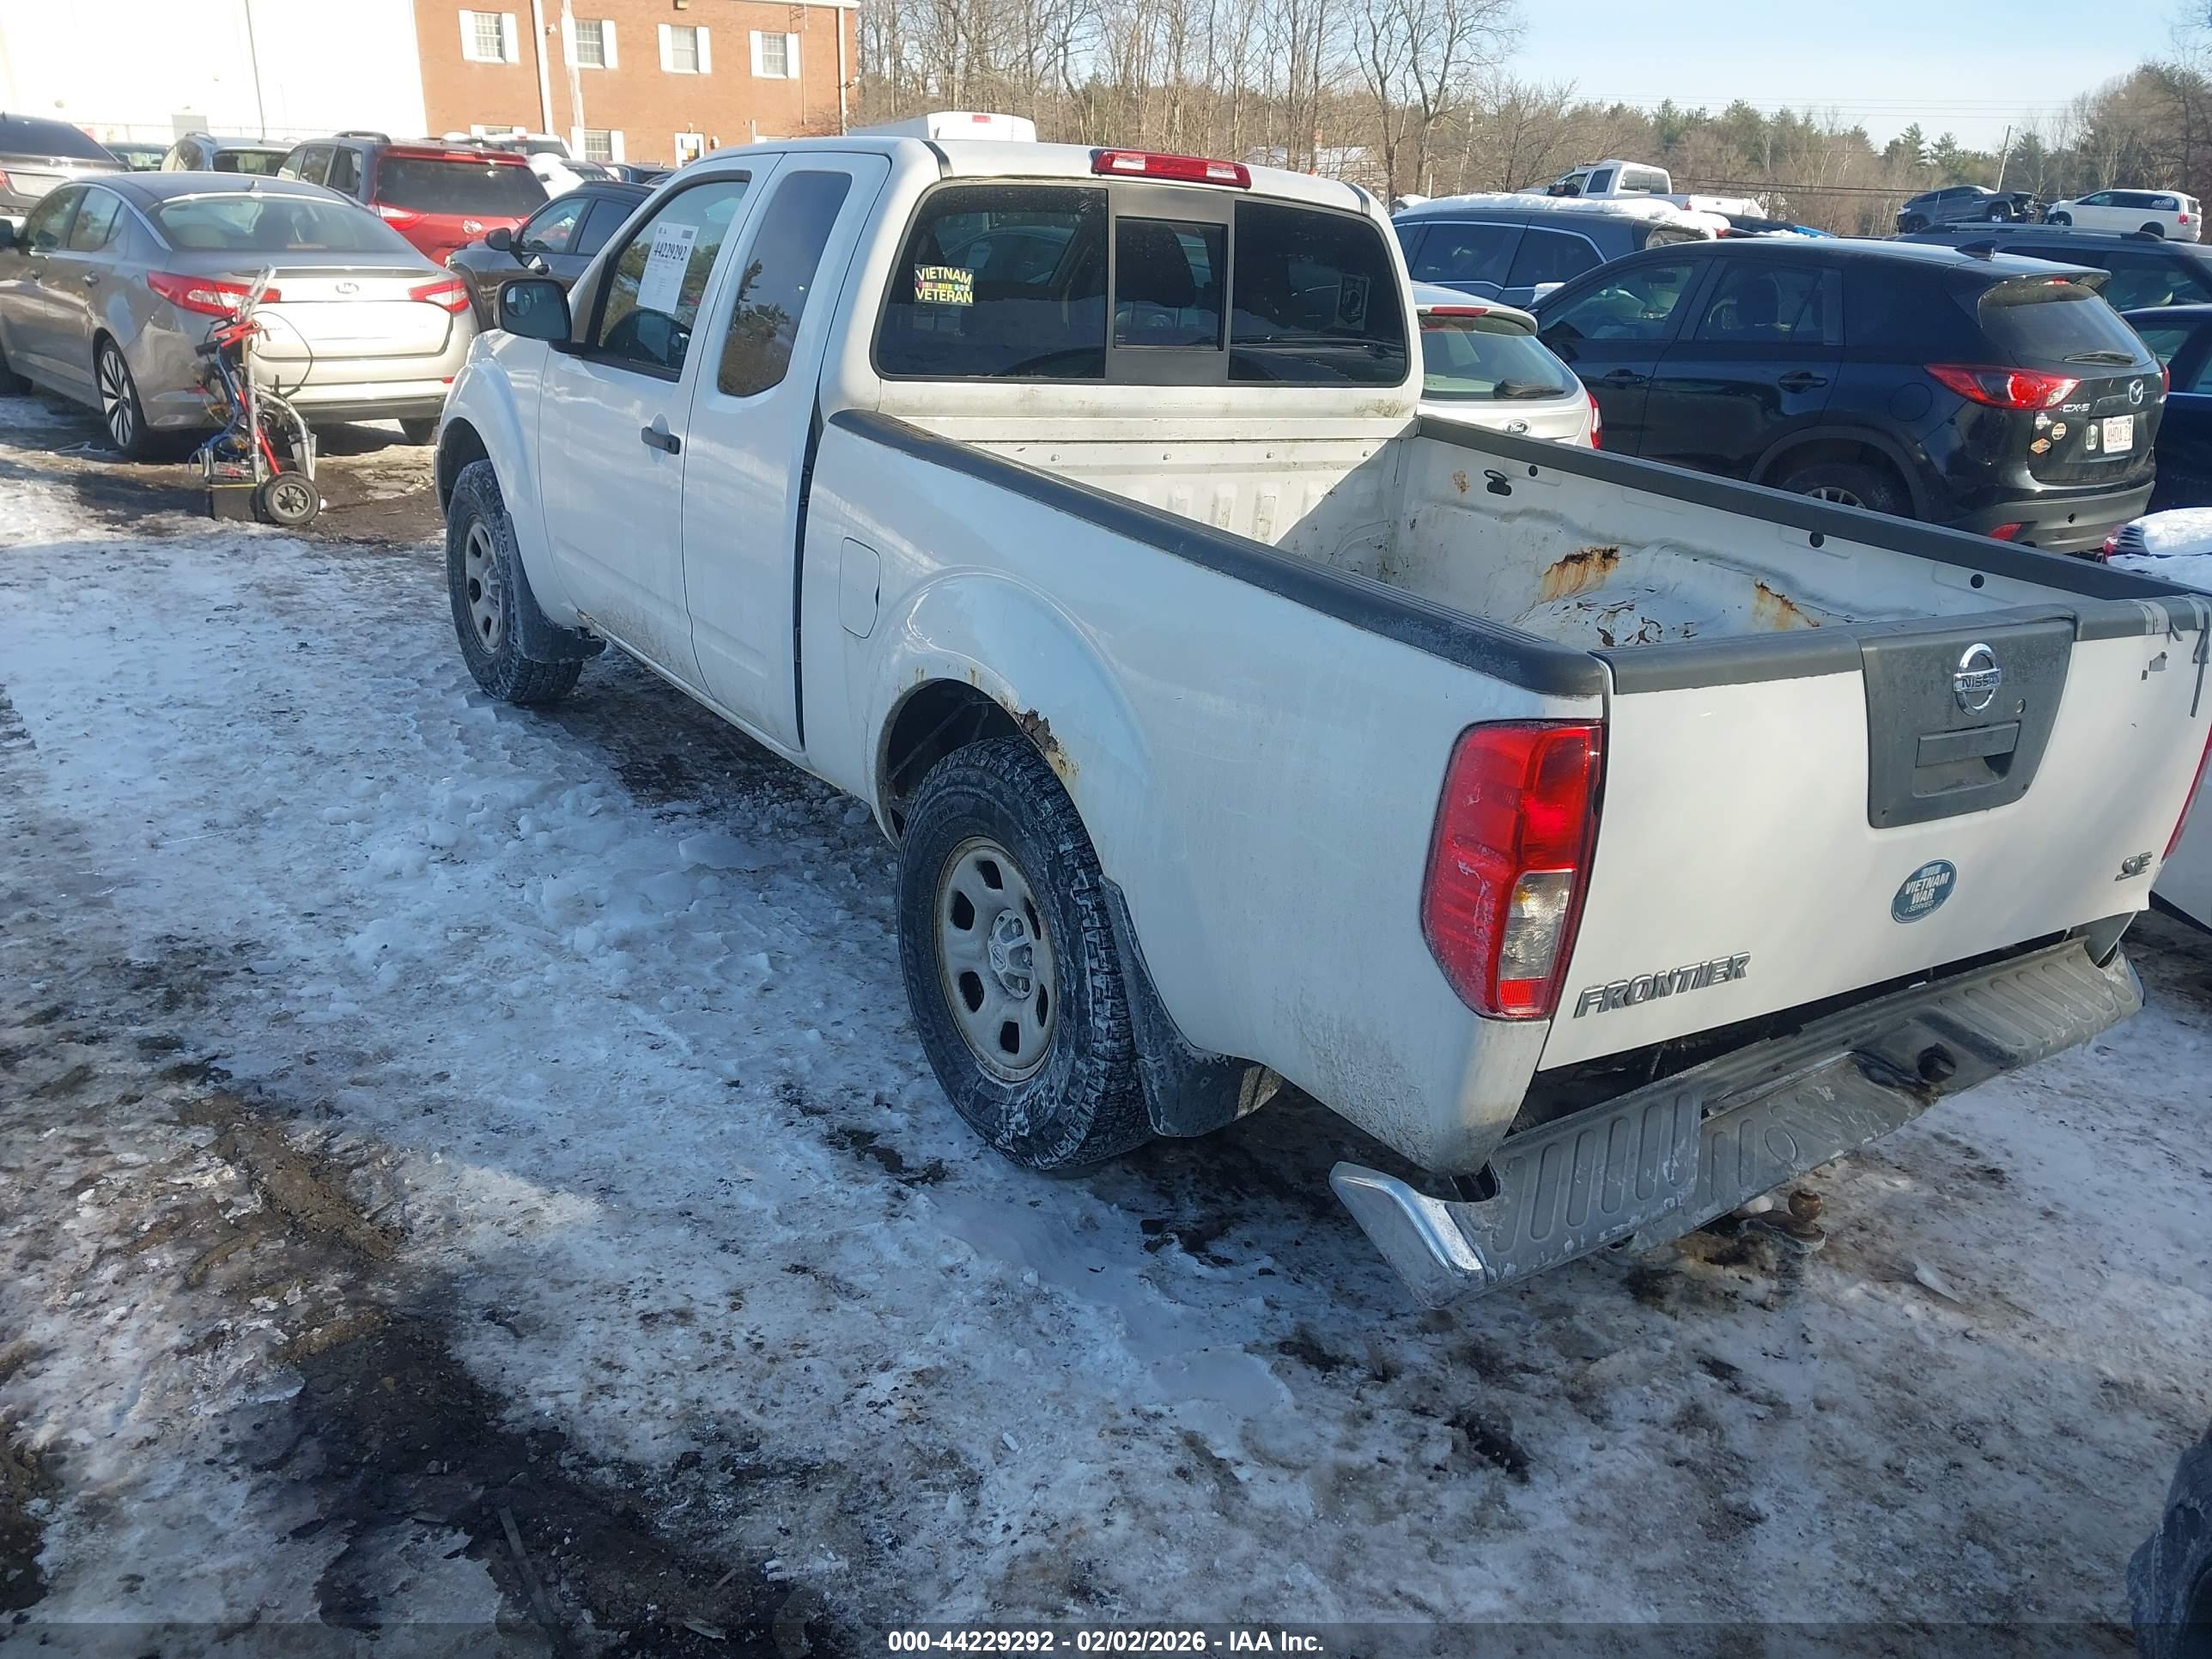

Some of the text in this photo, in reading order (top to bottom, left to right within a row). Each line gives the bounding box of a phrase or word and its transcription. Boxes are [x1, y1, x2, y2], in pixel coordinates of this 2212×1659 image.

[653, 241, 687, 261] 44229292
[915, 266, 973, 285] VIETNAM
[915, 287, 973, 303] VETERAN
[1961, 672, 2000, 688] NISSAN
[2114, 851, 2153, 882] SE
[1905, 872, 1951, 895] VIETNAM
[1911, 888, 1936, 905] WAR
[1572, 951, 1752, 1019] FRONTIER
